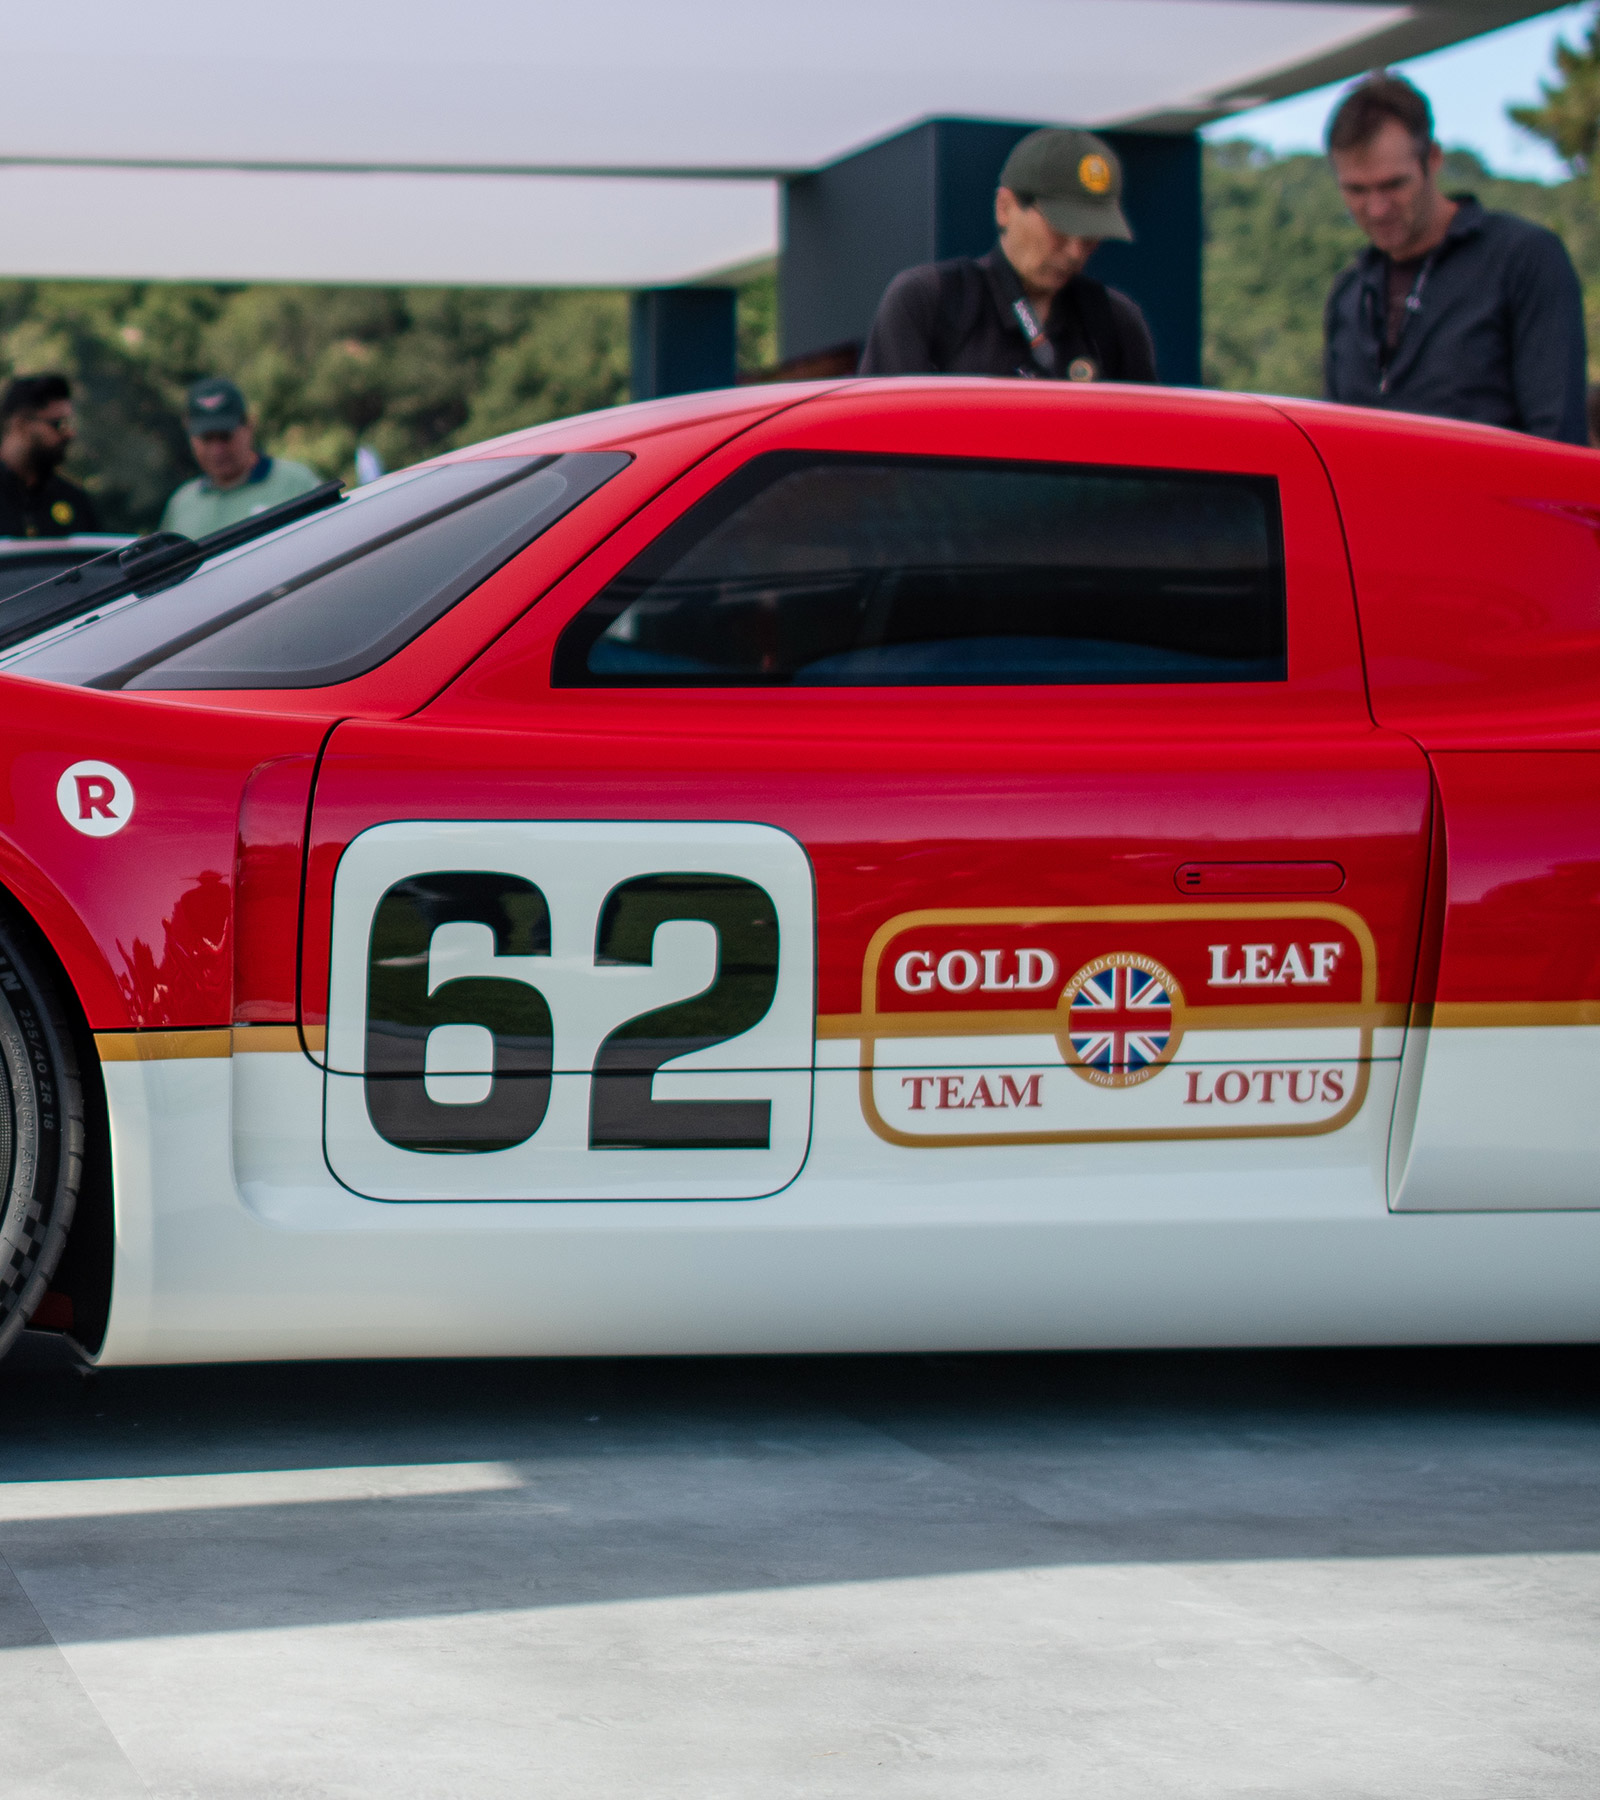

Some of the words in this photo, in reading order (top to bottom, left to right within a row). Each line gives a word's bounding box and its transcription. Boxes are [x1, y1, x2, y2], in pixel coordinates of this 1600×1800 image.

[73, 774, 120, 819] R
[895, 949, 1056, 993] GOLD
[1207, 942, 1343, 986] LEAF
[1064, 959, 1104, 998] WORLD
[1106, 954, 1178, 995] CHAMPIONS
[364, 870, 780, 1155] 62
[18, 1008, 47, 1074] 225/40
[38, 1079, 52, 1105] ZR
[902, 1074, 1044, 1110] TEAM
[1183, 1069, 1344, 1104] LOTUS
[1089, 1071, 1114, 1086] 1968
[1124, 1070, 1150, 1085] 1970
[42, 1113, 53, 1130] 18
